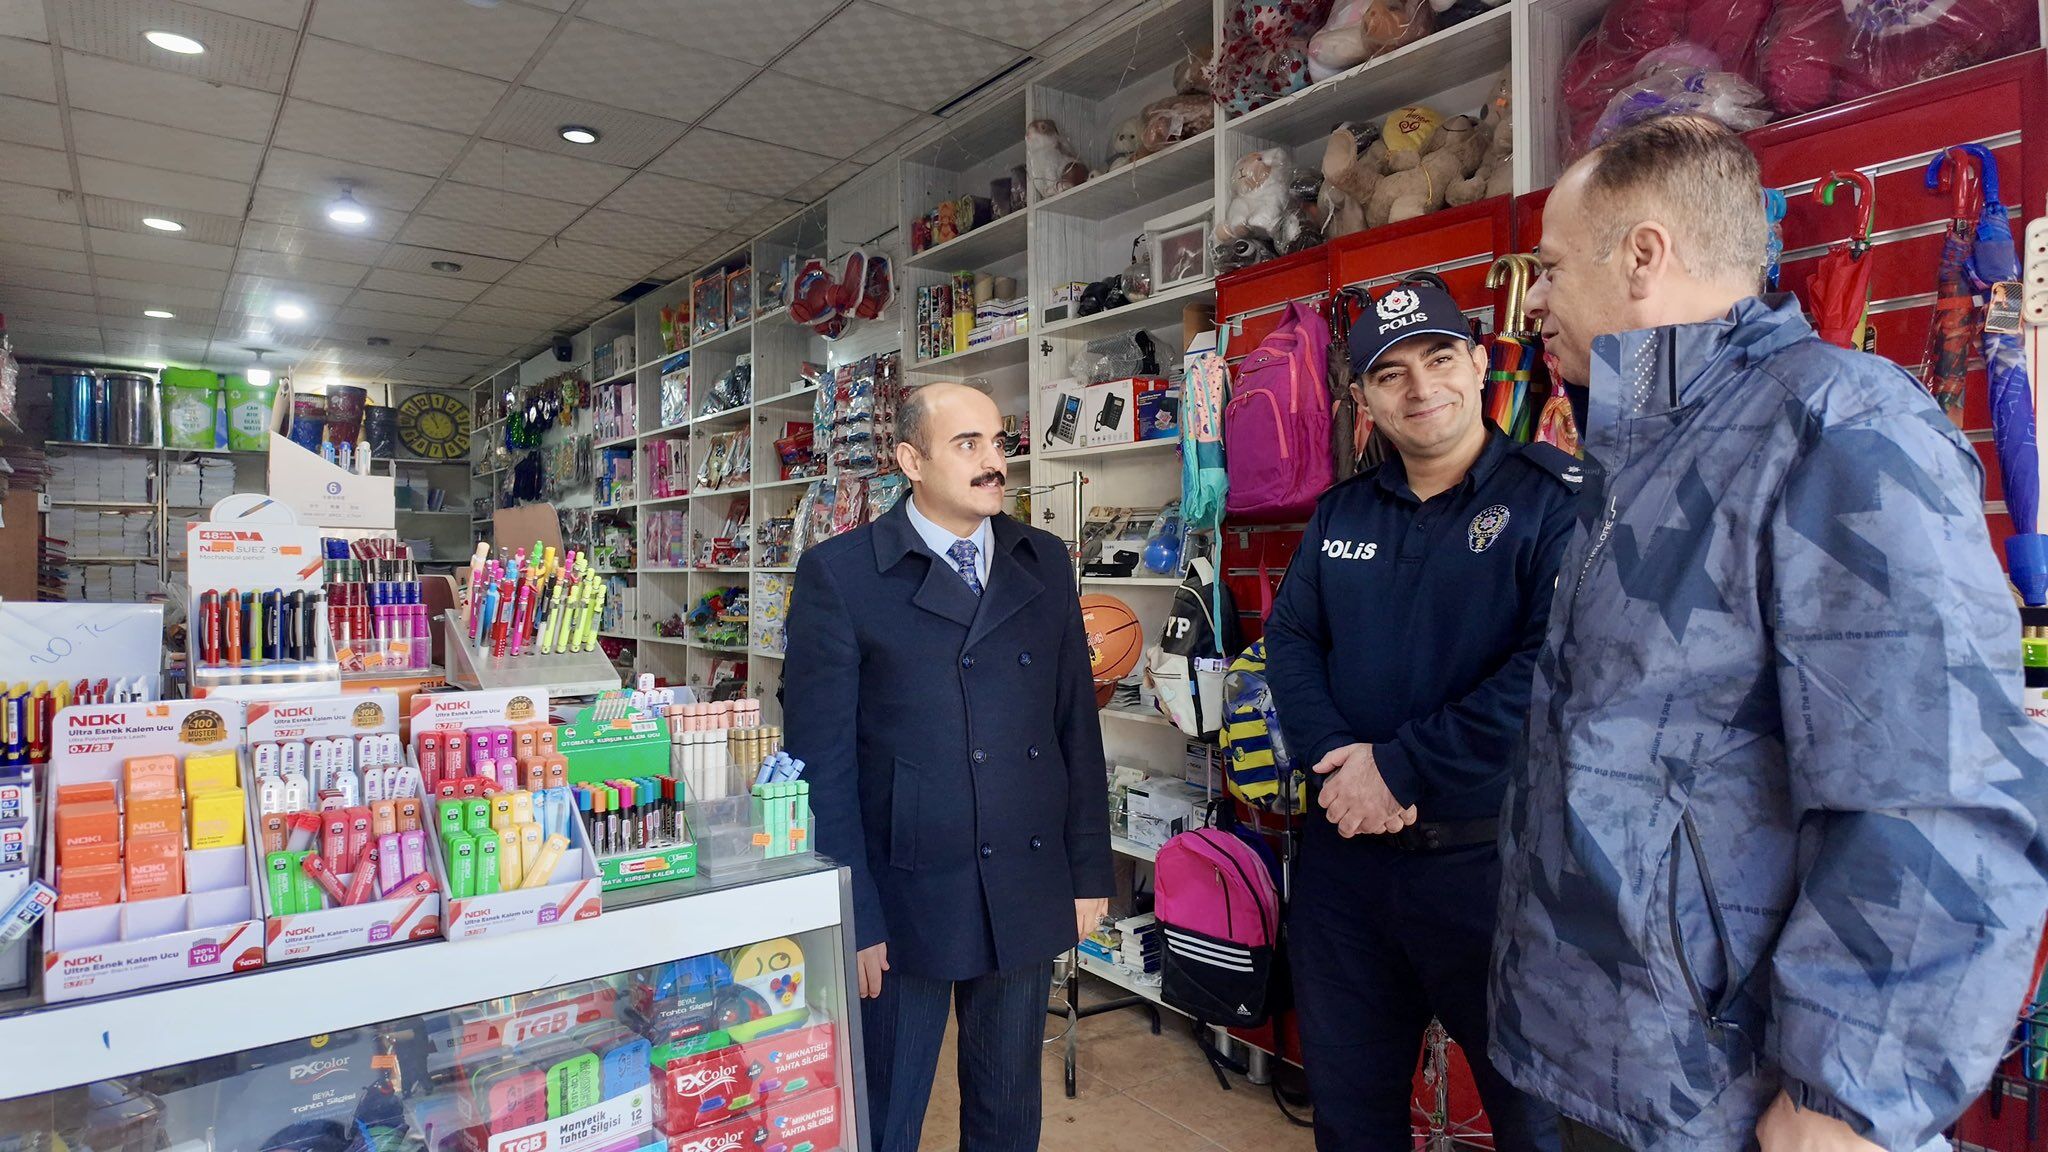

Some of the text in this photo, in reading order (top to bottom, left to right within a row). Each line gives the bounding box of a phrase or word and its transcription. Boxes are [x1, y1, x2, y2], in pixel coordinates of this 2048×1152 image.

[329, 483, 337, 493] 6
[202, 531, 218, 539] 48
[1845, 631, 1862, 640] the
[1864, 630, 1908, 639] summer
[435, 700, 470, 711] NOKI
[274, 706, 313, 718] NOKI
[69, 713, 126, 728] NOKI
[274, 717, 291, 725] Ultra
[291, 716, 311, 724] Esnek
[312, 715, 332, 723] Kalem
[68, 724, 174, 737] Ultra Esnek Kalem Ucu
[131, 780, 161, 789] NOKI
[3, 800, 16, 808] 0.7
[132, 820, 165, 830] NOKI
[67, 835, 102, 846] NOKI
[6, 843, 19, 851] 0.7
[131, 863, 166, 874] NOKI
[652, 870, 674, 878] KALEM
[63, 890, 99, 900] NOKI
[465, 908, 491, 918] NOKI
[464, 918, 481, 926] Ultra
[481, 915, 500, 923] Esnek
[285, 926, 315, 937] NOKI
[285, 935, 303, 944] Ultra
[304, 932, 325, 941] Esnek
[327, 929, 349, 937] Kalem
[63, 954, 103, 967] NOKI
[64, 965, 90, 976] Ultra
[93, 960, 124, 971] Esnek
[126, 955, 158, 966] Kalem
[160, 951, 179, 961] Ucu
[194, 953, 215, 963] TÜP
[241, 958, 261, 967] NOKI
[678, 996, 697, 1007] BEYAZ
[660, 1008, 687, 1018] Tahta
[514, 1012, 568, 1041] TGB
[786, 1042, 828, 1061] MIKNATISLI
[775, 1060, 801, 1074] TAHTA
[312, 1089, 336, 1101] BEYAZ
[290, 1101, 324, 1114] Tahta
[631, 1108, 642, 1121] 12
[791, 1105, 834, 1125] MIKNATISLI
[560, 1110, 606, 1135] Manyetik
[560, 1114, 621, 1145] Tahta Silgisi
[781, 1124, 806, 1139] TAHTA
[505, 1135, 543, 1152] TGB
